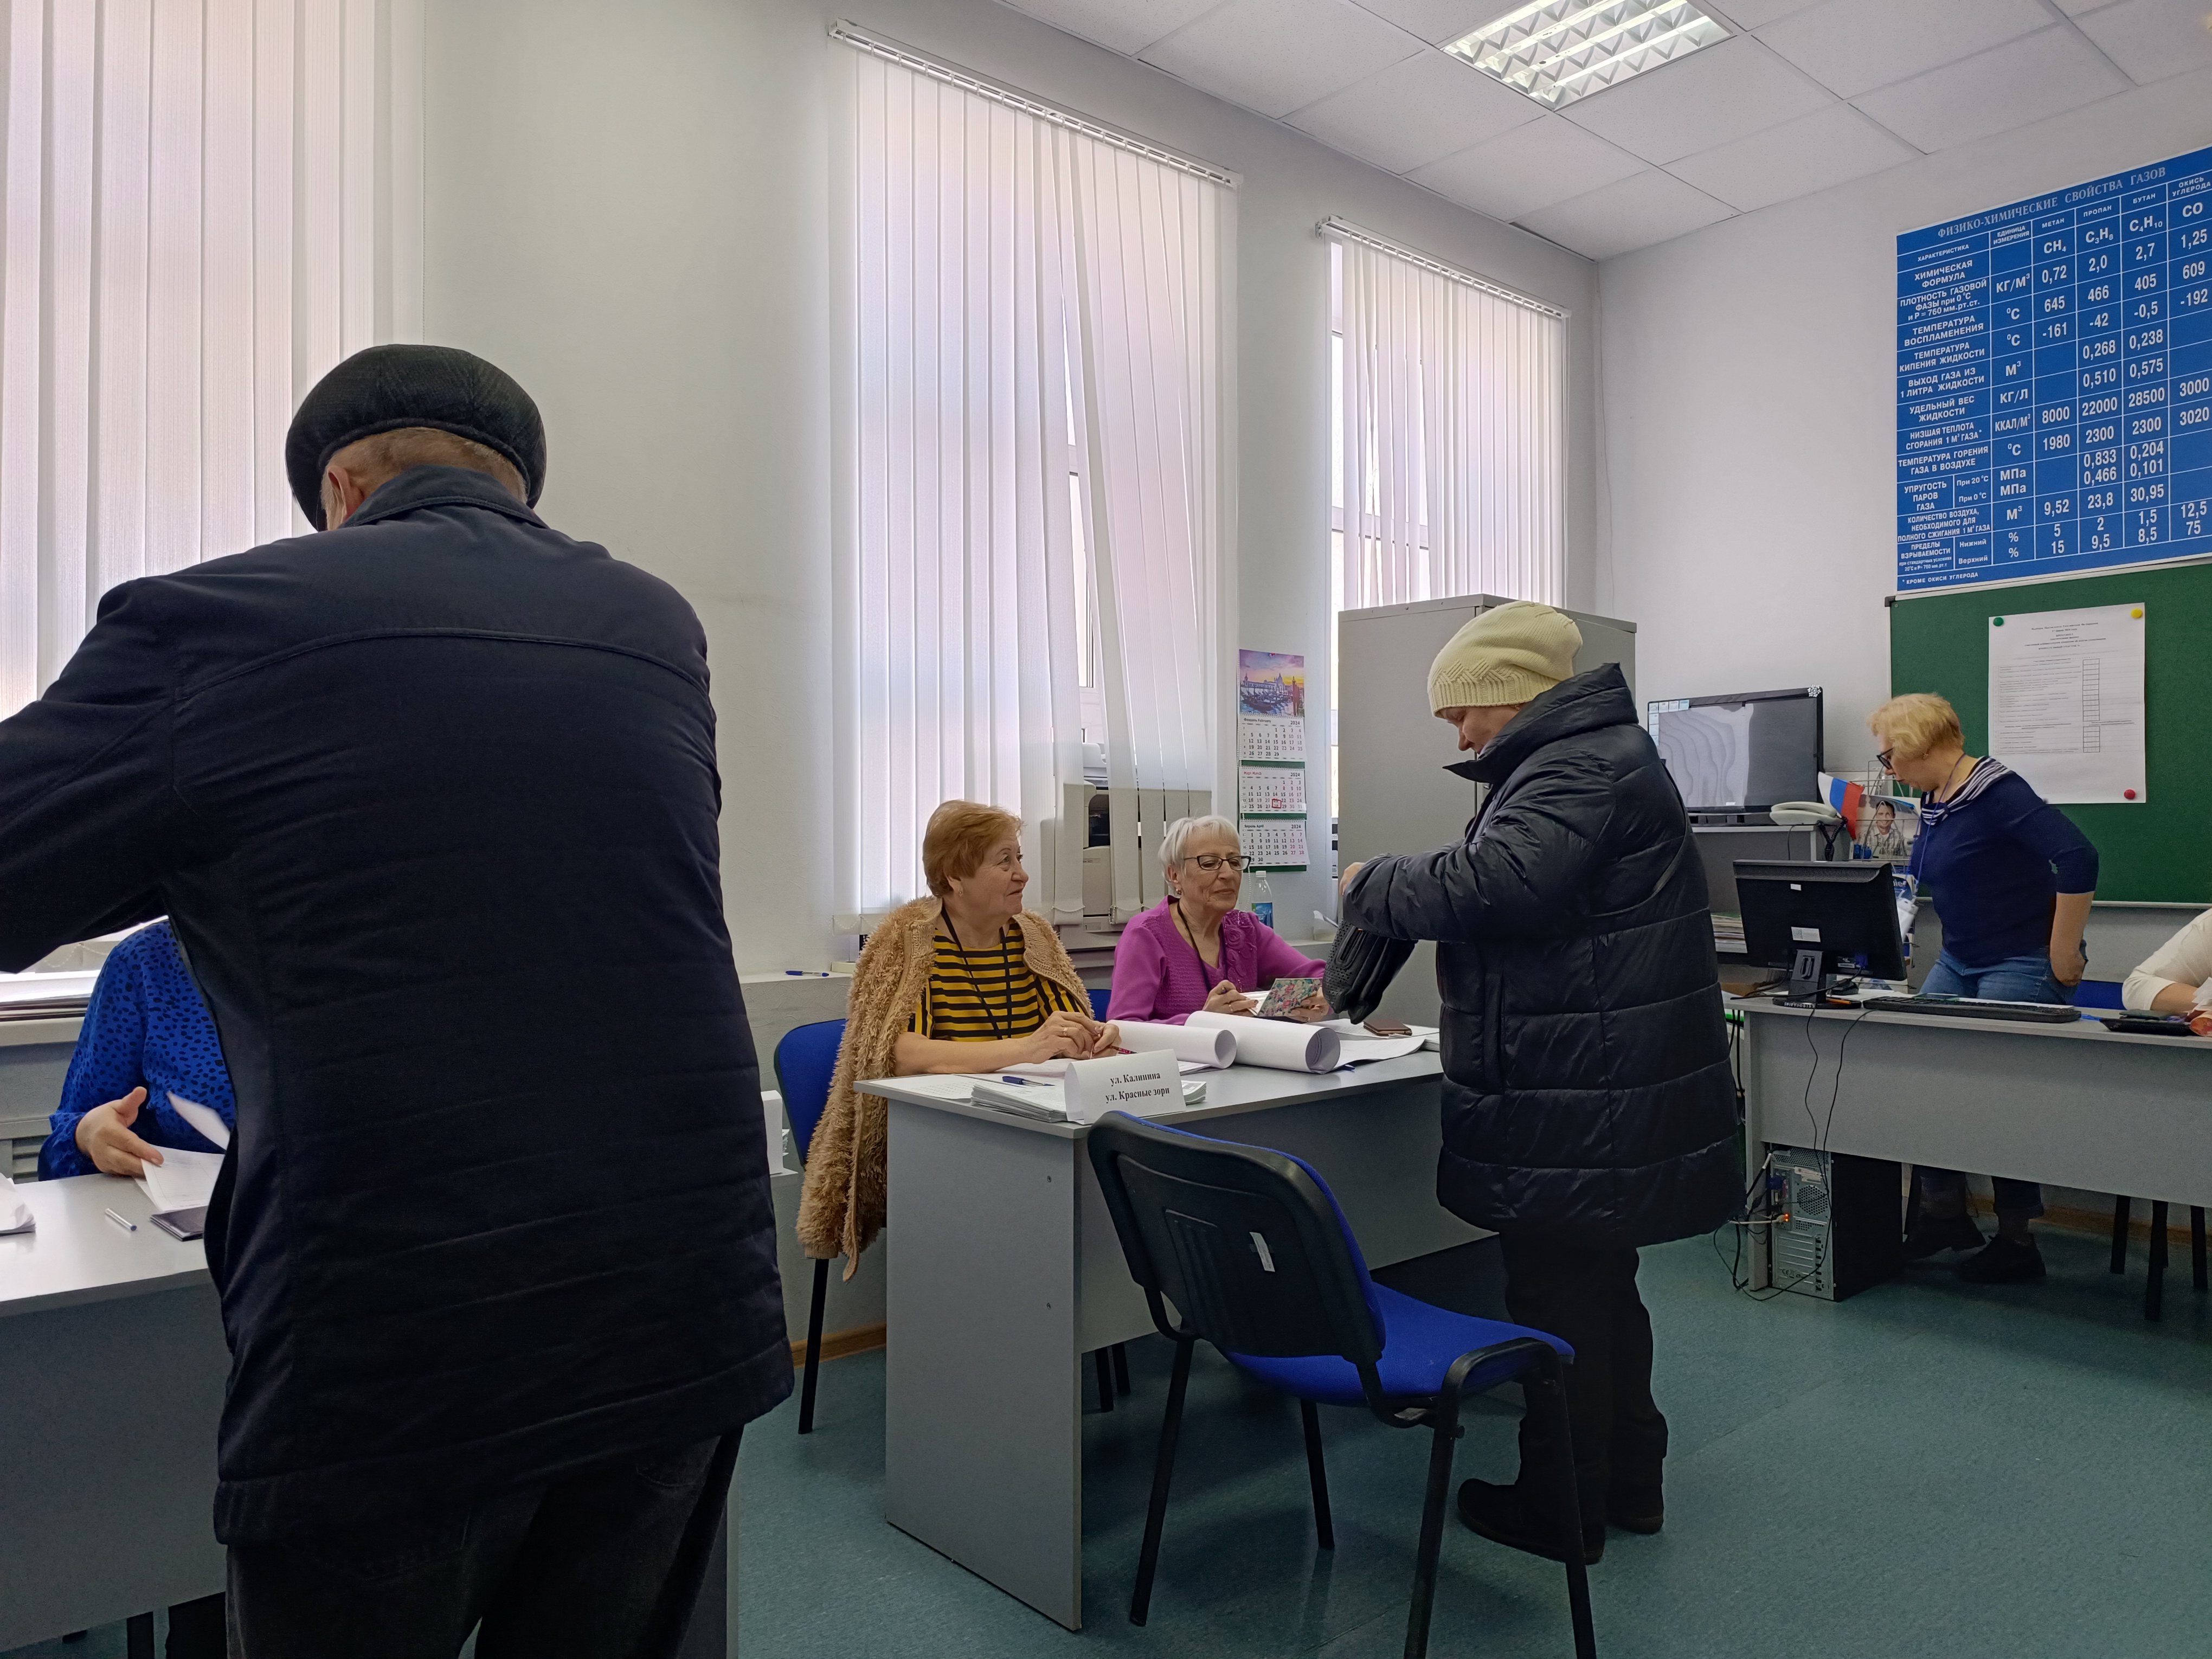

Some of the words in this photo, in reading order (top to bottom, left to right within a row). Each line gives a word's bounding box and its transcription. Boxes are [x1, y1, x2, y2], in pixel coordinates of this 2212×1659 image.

[2172, 182, 2211, 196] УГЛЕРОДА
[2178, 176, 2204, 188] ОКИСЬ
[1938, 197, 2058, 238] ФИЗИКО-ХИМИЧЕСКИЕ
[2065, 179, 2123, 203] СВОЙСТВА
[2131, 167, 2166, 185] ГАЗОВ
[2133, 193, 2156, 204] БУТАН
[2084, 205, 2112, 217] ПРОПАН
[1997, 226, 2025, 237] ЕДИНИЦА
[2042, 218, 2065, 228] МЕТАН
[1994, 230, 2030, 245] ИЗМЕРЕНИЯ
[2181, 229, 2208, 249] 1,25
[1918, 244, 1969, 262] ХАРАКТЕРИСТИКА
[2136, 242, 2155, 261] 2,7
[1914, 260, 1973, 281] ХИМИЧЕСКАЯ
[2089, 255, 2107, 273] 2,0
[2183, 261, 2205, 279] 609
[1922, 272, 1965, 288] ФОРМУЛА
[2042, 265, 2067, 285] 0,72
[2135, 273, 2157, 291] 405
[1900, 291, 1947, 307] ПЛОТНОСТЬ
[1950, 279, 1987, 294] ГАЗОВОЙ
[2088, 285, 2109, 301] 466
[2180, 288, 2208, 306] -192
[1915, 299, 1939, 311] ФАЗЫ
[1941, 297, 1955, 307] при
[1928, 307, 1942, 317] 760
[2044, 295, 2065, 312] 645
[2134, 301, 2158, 319] -0,5
[1913, 315, 1975, 335] ТЕМПЕРАТУРА
[2089, 312, 2108, 327] -42
[1904, 323, 1984, 347] ВОСПЛАМЕНЕНИЯ
[2042, 321, 2067, 338] -161
[2129, 329, 2163, 350] 0,238
[1914, 342, 1970, 360] ТЕМПЕРАТУРА
[2082, 340, 2115, 360] 0,268
[1899, 358, 1936, 372] КИПЕНИЯ
[1940, 348, 1985, 364] ЖИДКОСТИ
[2130, 358, 2163, 379] 0,575
[1908, 375, 1938, 387] ВЫХОД
[1941, 371, 1961, 381] ГАЗА
[1964, 367, 1976, 376] ИЗ
[2083, 368, 2116, 389] 0,510
[1906, 386, 1933, 397] ЛИТРА
[1938, 375, 1984, 391] ЖИДКОСТИ
[2179, 377, 2209, 397] 3000
[2000, 389, 2028, 403] КГ/Л
[2129, 387, 2165, 407] 28500
[1909, 398, 1954, 415] УДЕЛЬНЫЙ
[1958, 396, 1975, 406] ВЕС
[2082, 397, 2118, 416] 22000
[1919, 407, 1965, 422] ЖИДКОСТИ
[2042, 406, 2070, 424] 8000
[2179, 407, 2209, 426] 3020
[1910, 428, 1940, 440] НИЗШАЯ
[1942, 422, 1974, 434] ТЕПЛОТА
[2132, 416, 2162, 435] 2300
[2043, 434, 2070, 451] 1980
[2086, 426, 2114, 443] 2300
[1906, 438, 1943, 451] СГОРАНИЯ
[2130, 440, 2164, 461] 0,204
[1898, 453, 1951, 467] ТЕМПЕРАТУРА
[1953, 446, 1988, 459] ГОРЕНИЯ
[2084, 449, 2117, 469] 0,833
[1911, 466, 1929, 475] ГАЗА
[1940, 458, 1976, 471] ВОЗДУХЕ
[2000, 468, 2026, 481] МПа
[2130, 459, 2163, 479] 0,101
[2084, 467, 2117, 487] 0,466
[1904, 481, 1947, 494] УПРУГОСТЬ
[2000, 484, 2026, 496] МПа
[2130, 484, 2164, 503] 30,95
[1913, 492, 1938, 502] ПАРОВ
[2087, 492, 2113, 510] 23,8
[1917, 502, 1934, 511] ГАЗА
[2044, 499, 2069, 517] 9,52
[2181, 501, 2207, 519] 12,5
[1908, 512, 1947, 524] КОЛИЧЕСТВО
[1949, 508, 1979, 518] ВОЗДУХА,
[1911, 519, 1960, 531] НЕОБХОДИМОГО
[1963, 517, 1976, 526] ДЛЯ
[2097, 517, 2104, 531] 2
[2139, 509, 2157, 527] 1,5
[1898, 533, 1926, 542] ПОЛНОГО
[1928, 528, 1960, 538] СЖИГАНИЯ
[2054, 524, 2061, 537] 5
[2138, 526, 2157, 544] 8,5
[2186, 520, 2201, 536] 75
[1911, 542, 1940, 550] ПРЕДЕЛЫ
[1959, 538, 1986, 548] Нижний
[2008, 532, 2018, 543] %
[2092, 534, 2110, 551] 9,5
[1901, 548, 1951, 559] ВЗРЫВАЕМОСТИ
[2009, 547, 2019, 558] %
[2052, 540, 2065, 554] 15
[1958, 555, 1988, 564] Верхний
[1949, 572, 1978, 580] УГЛЕРОДА
[1110, 1078, 1122, 1086] ул.
[1123, 1072, 1160, 1083] Калинина
[1105, 1094, 1117, 1104] ул.
[1118, 1090, 1152, 1101] Красные
[1153, 1088, 1169, 1097] зори
